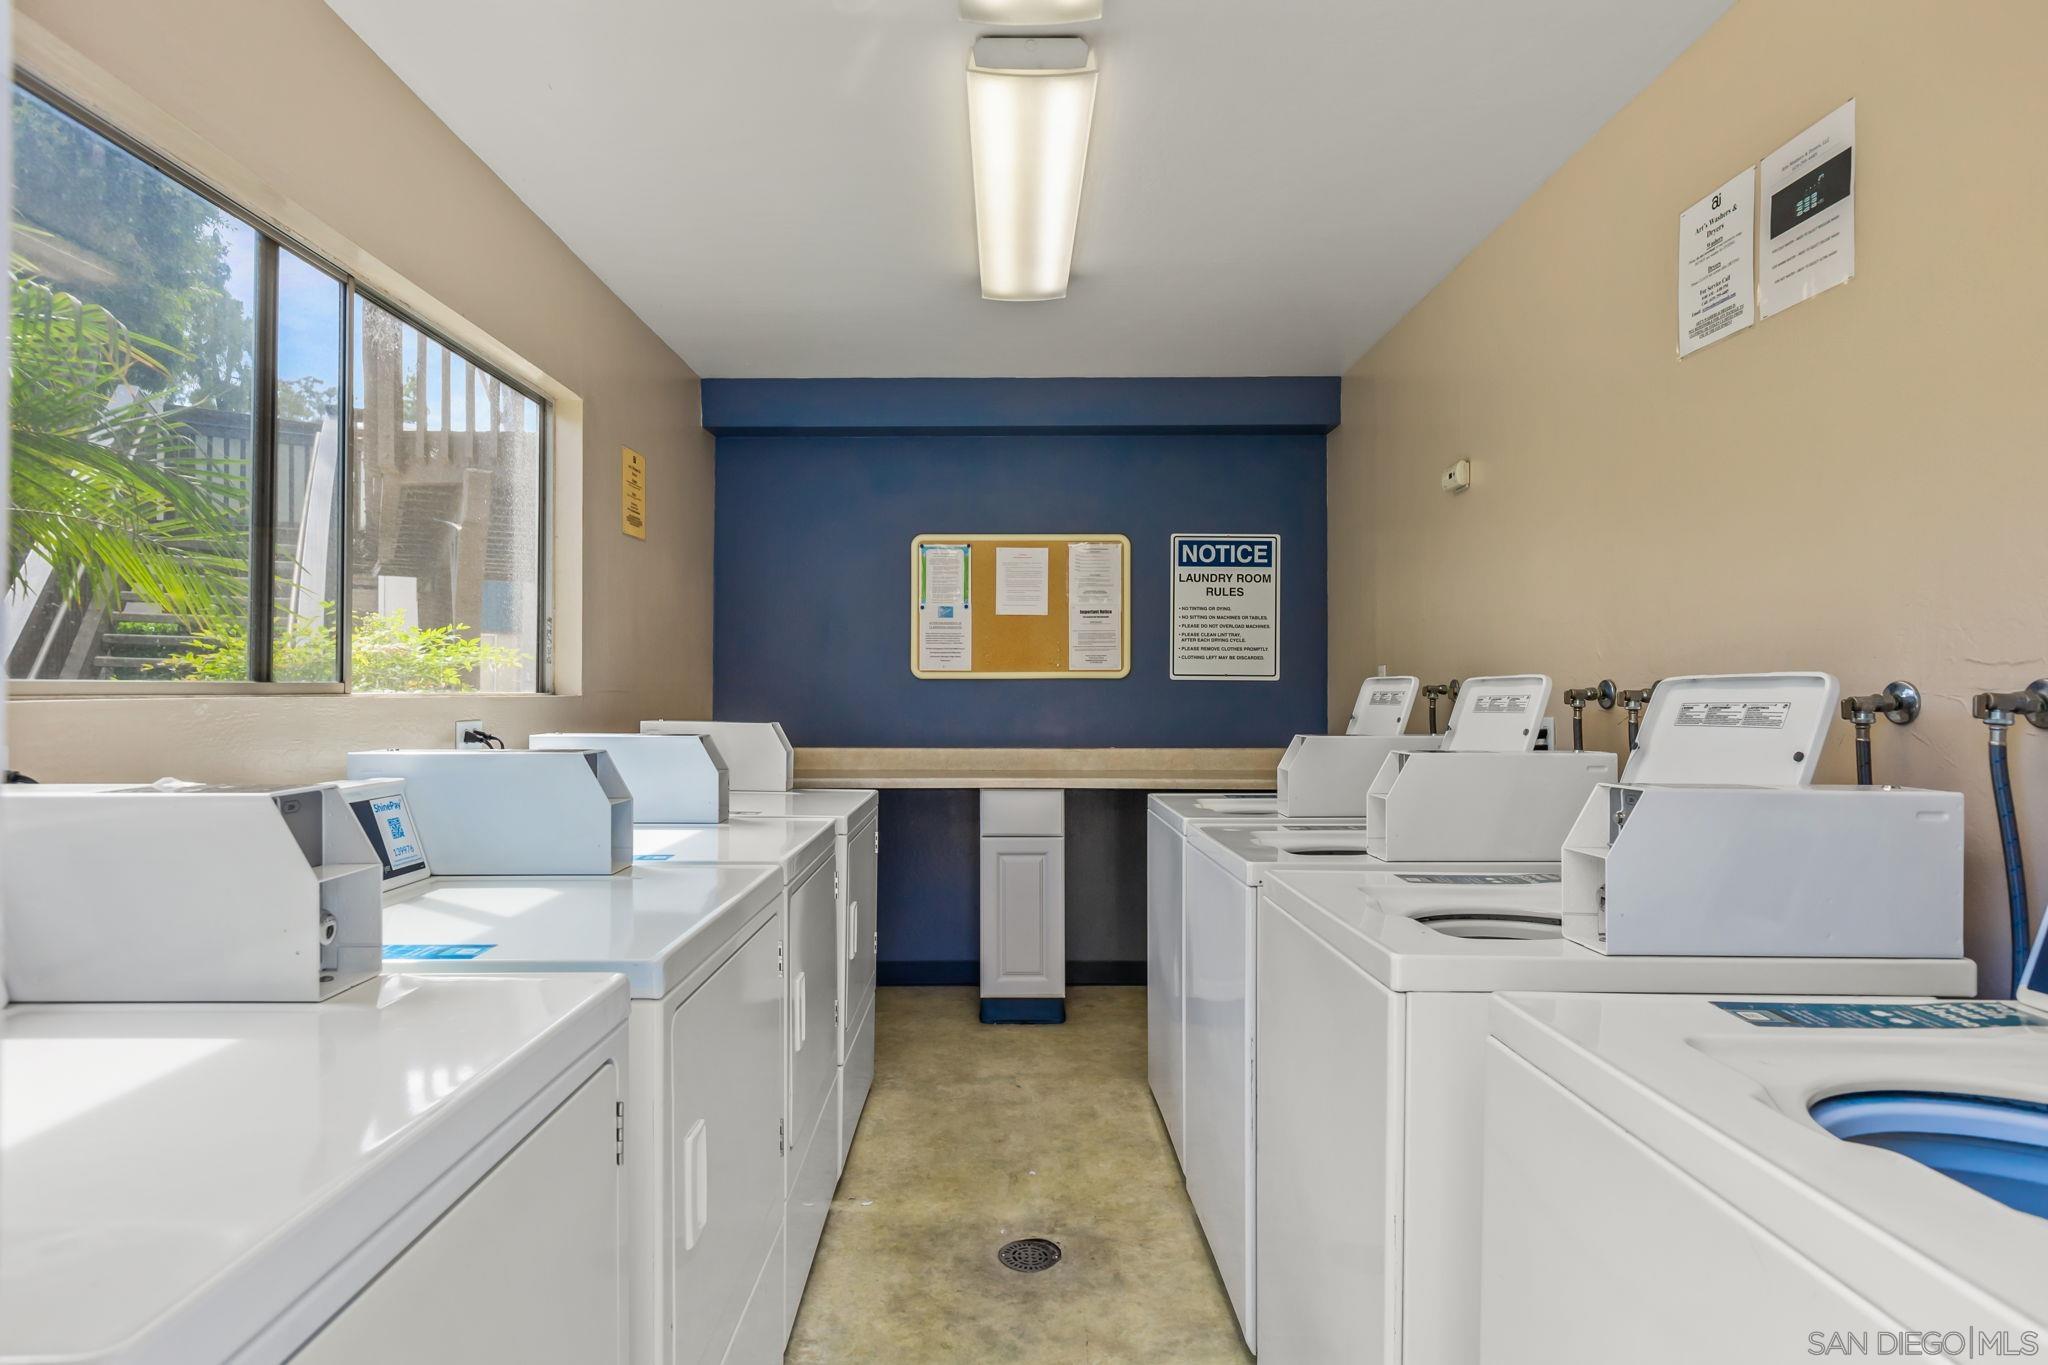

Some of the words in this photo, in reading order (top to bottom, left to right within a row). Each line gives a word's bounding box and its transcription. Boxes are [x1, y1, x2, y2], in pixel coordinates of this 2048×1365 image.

[1706, 224, 1724, 238] Dryers
[1182, 544, 1268, 563] NOTICE
[1179, 573, 1233, 583] LAUNDRY
[1236, 573, 1271, 583] ROOM
[1206, 587, 1244, 597] RULES
[373, 801, 401, 813] ShinePay
